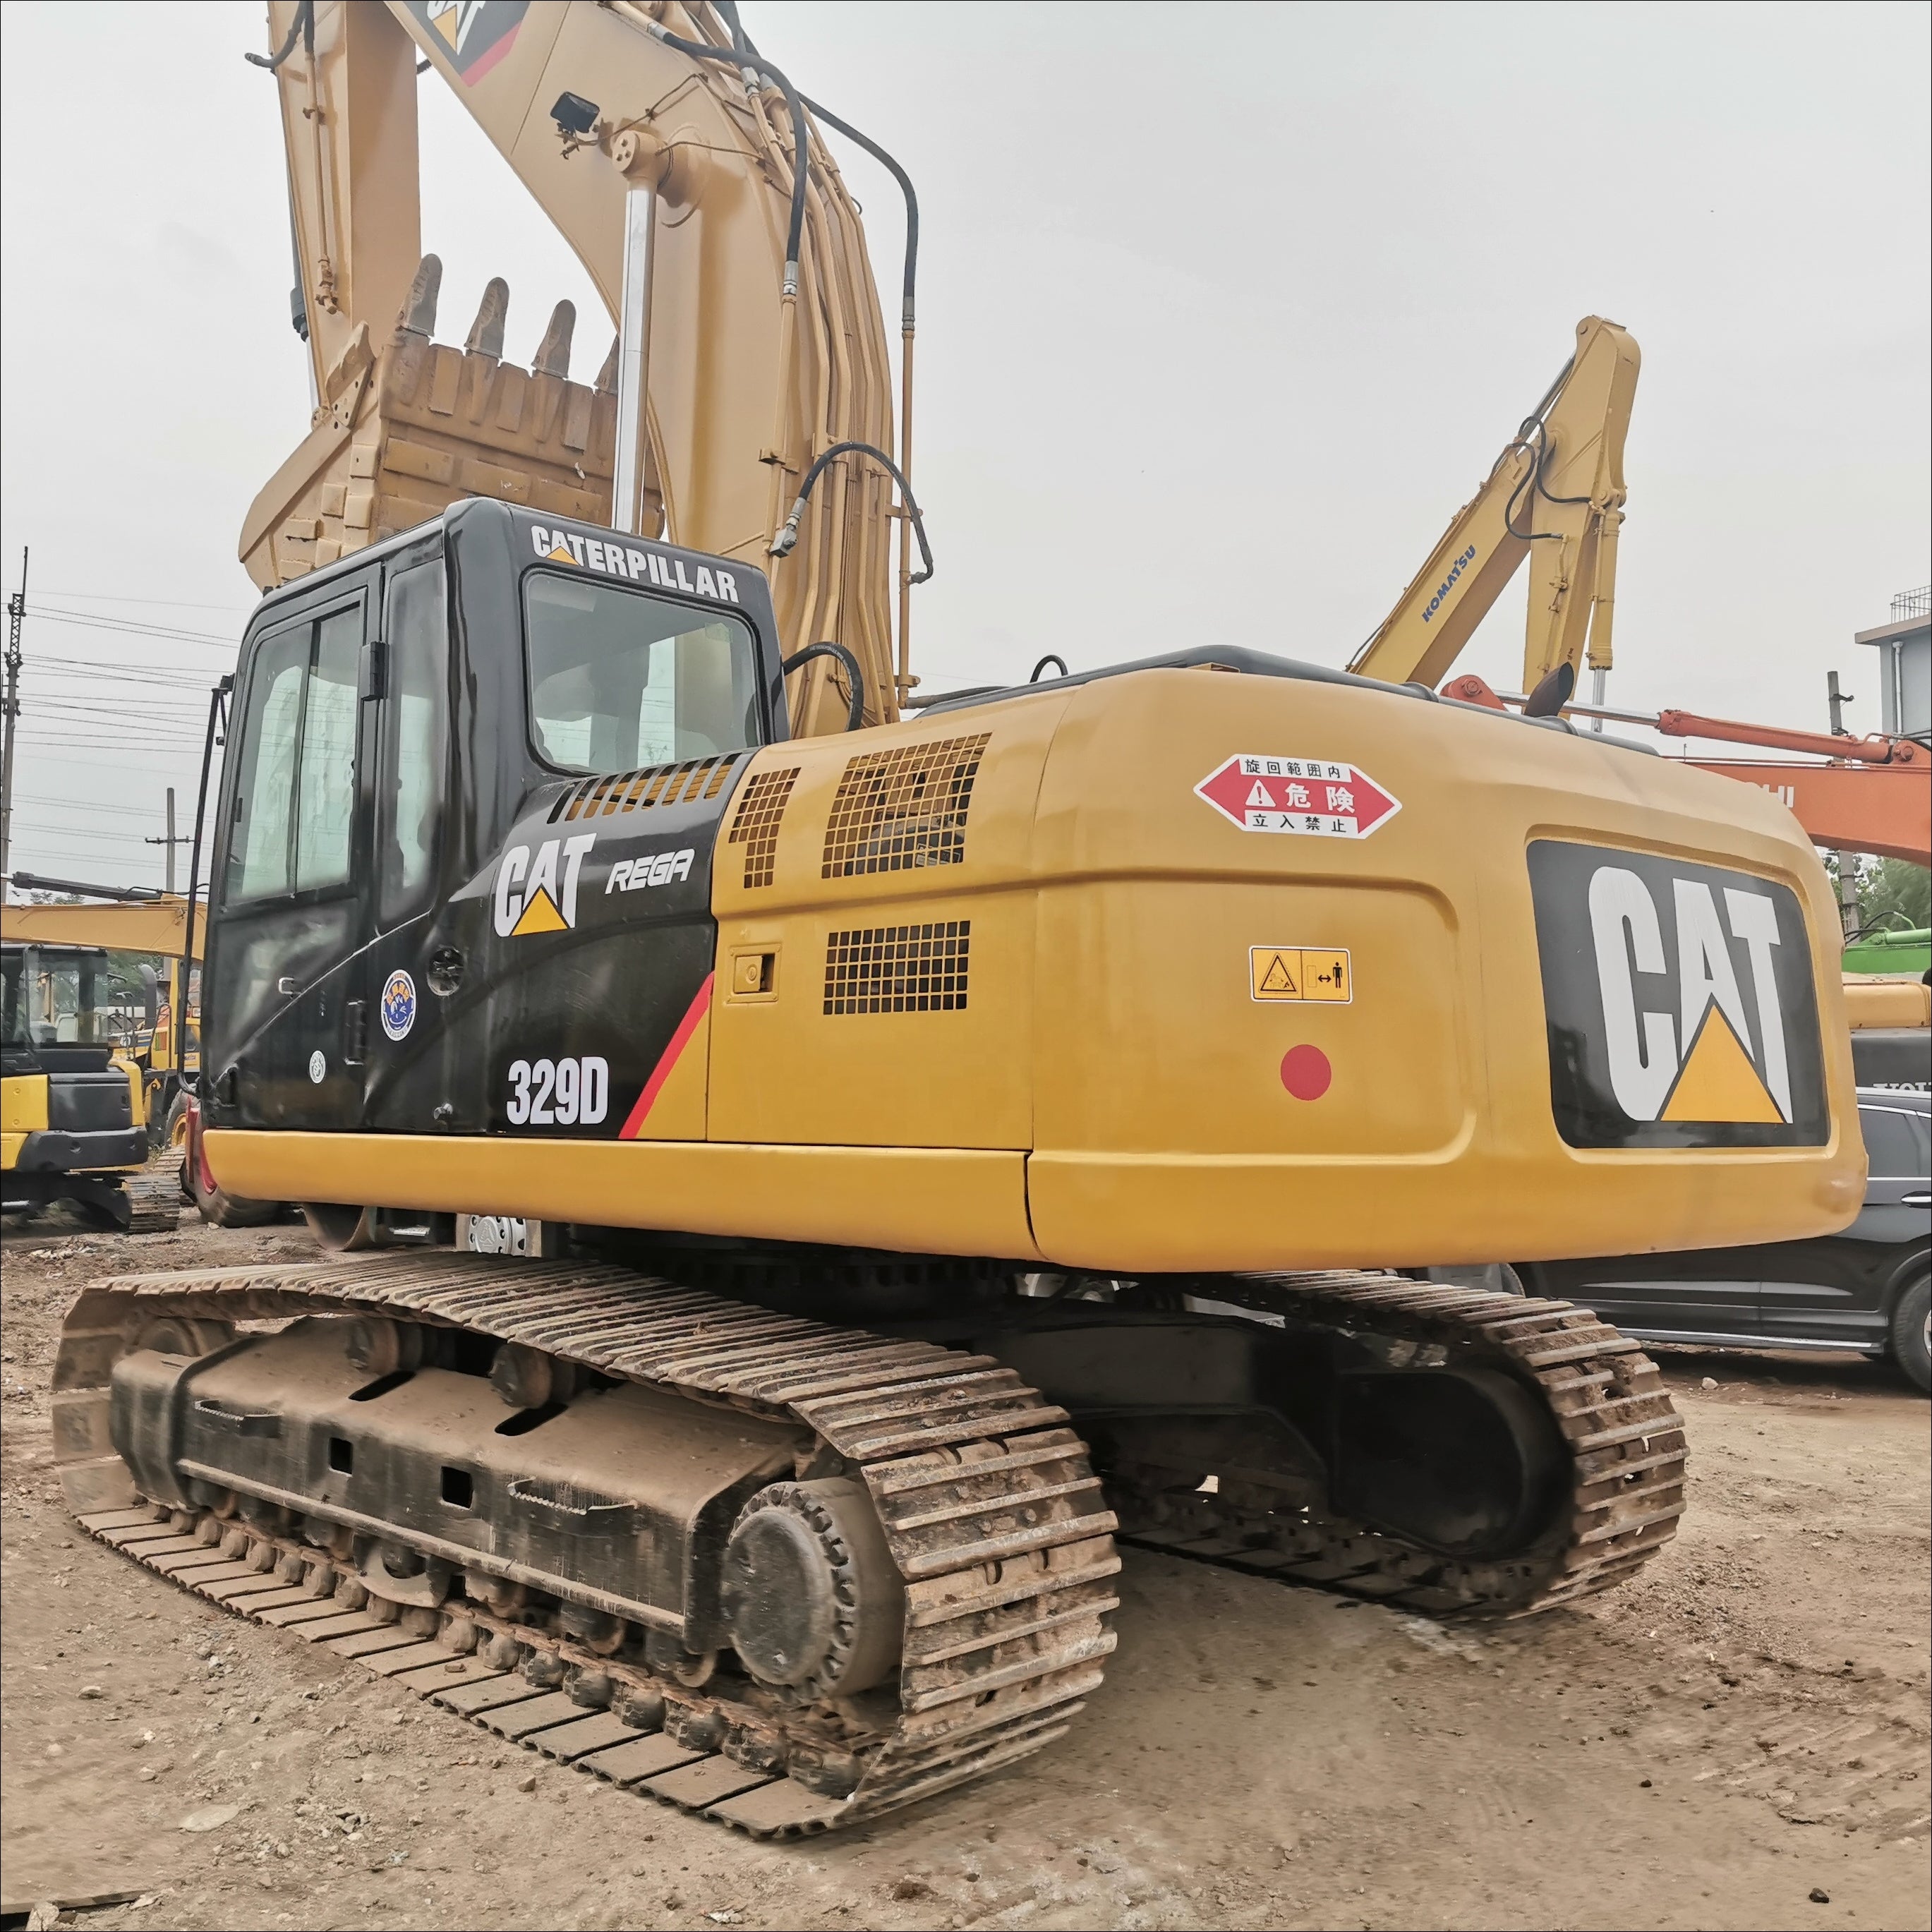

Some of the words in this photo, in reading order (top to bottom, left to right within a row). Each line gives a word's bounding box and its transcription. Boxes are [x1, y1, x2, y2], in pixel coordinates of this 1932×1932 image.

[531, 526, 739, 603] CATERPILLAR
[1422, 545, 1475, 622] KOMATSU
[1245, 759, 1340, 778] 旋回範囲内
[1285, 783, 1355, 814] 危険
[1253, 814, 1346, 833] 立入禁止
[495, 833, 596, 936] CAT
[605, 849, 694, 894] REGA
[1588, 866, 1793, 1124] CAT
[507, 1057, 608, 1125] 329D
